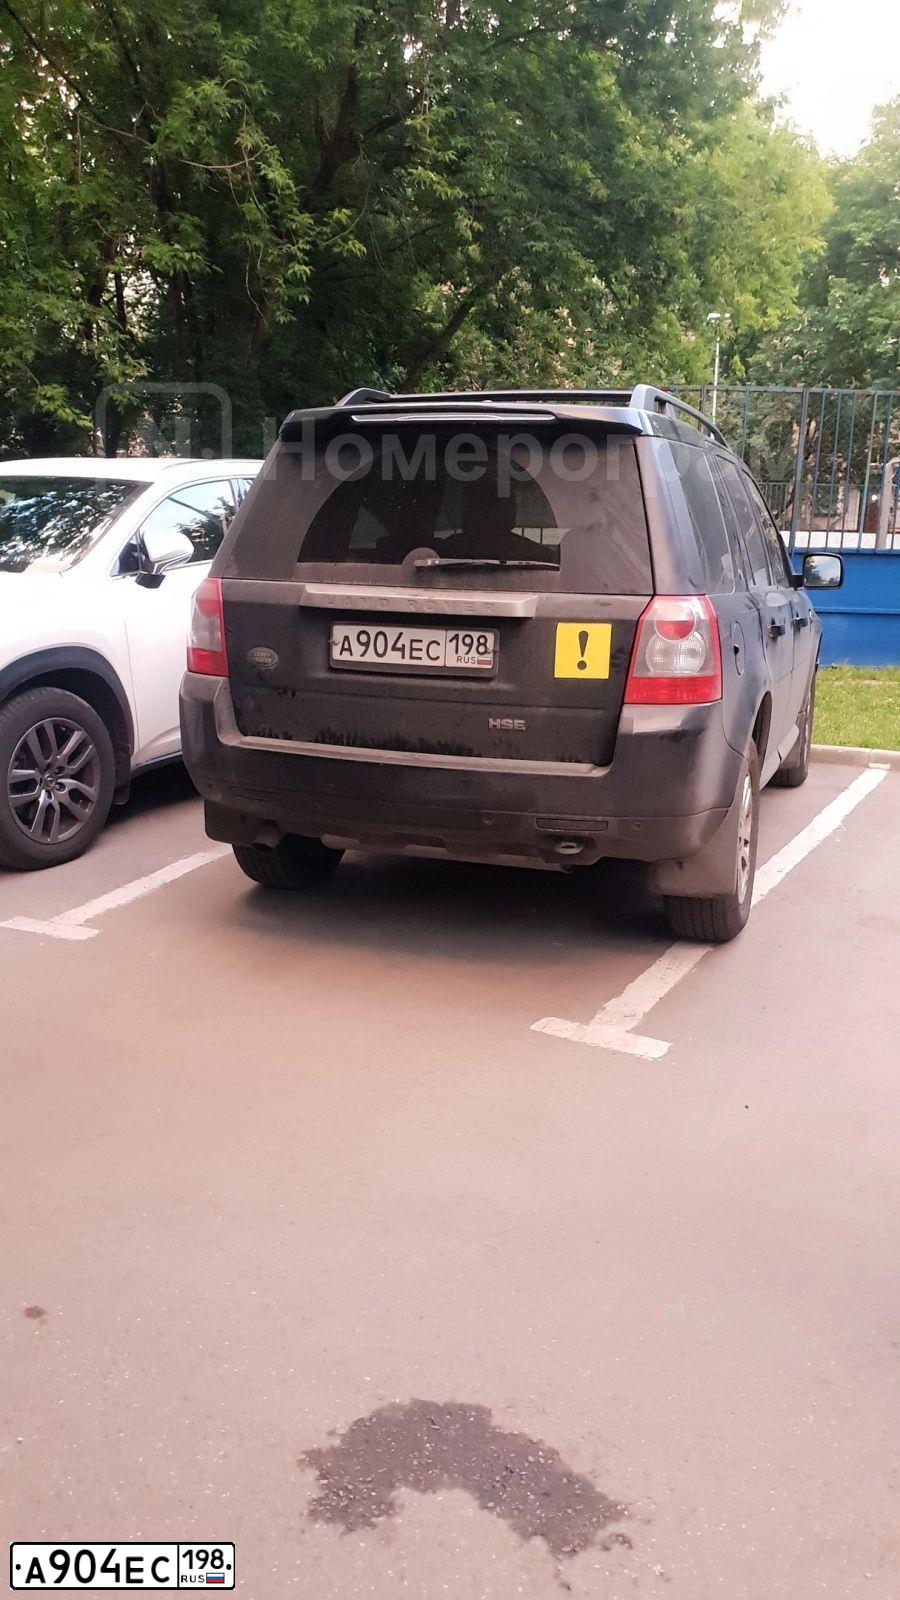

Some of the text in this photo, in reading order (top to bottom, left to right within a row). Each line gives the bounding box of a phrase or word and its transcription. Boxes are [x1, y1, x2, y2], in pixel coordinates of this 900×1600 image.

[339, 629, 489, 662] А904ЕС 198
[456, 655, 477, 665] RUS
[488, 718, 526, 731] HSE
